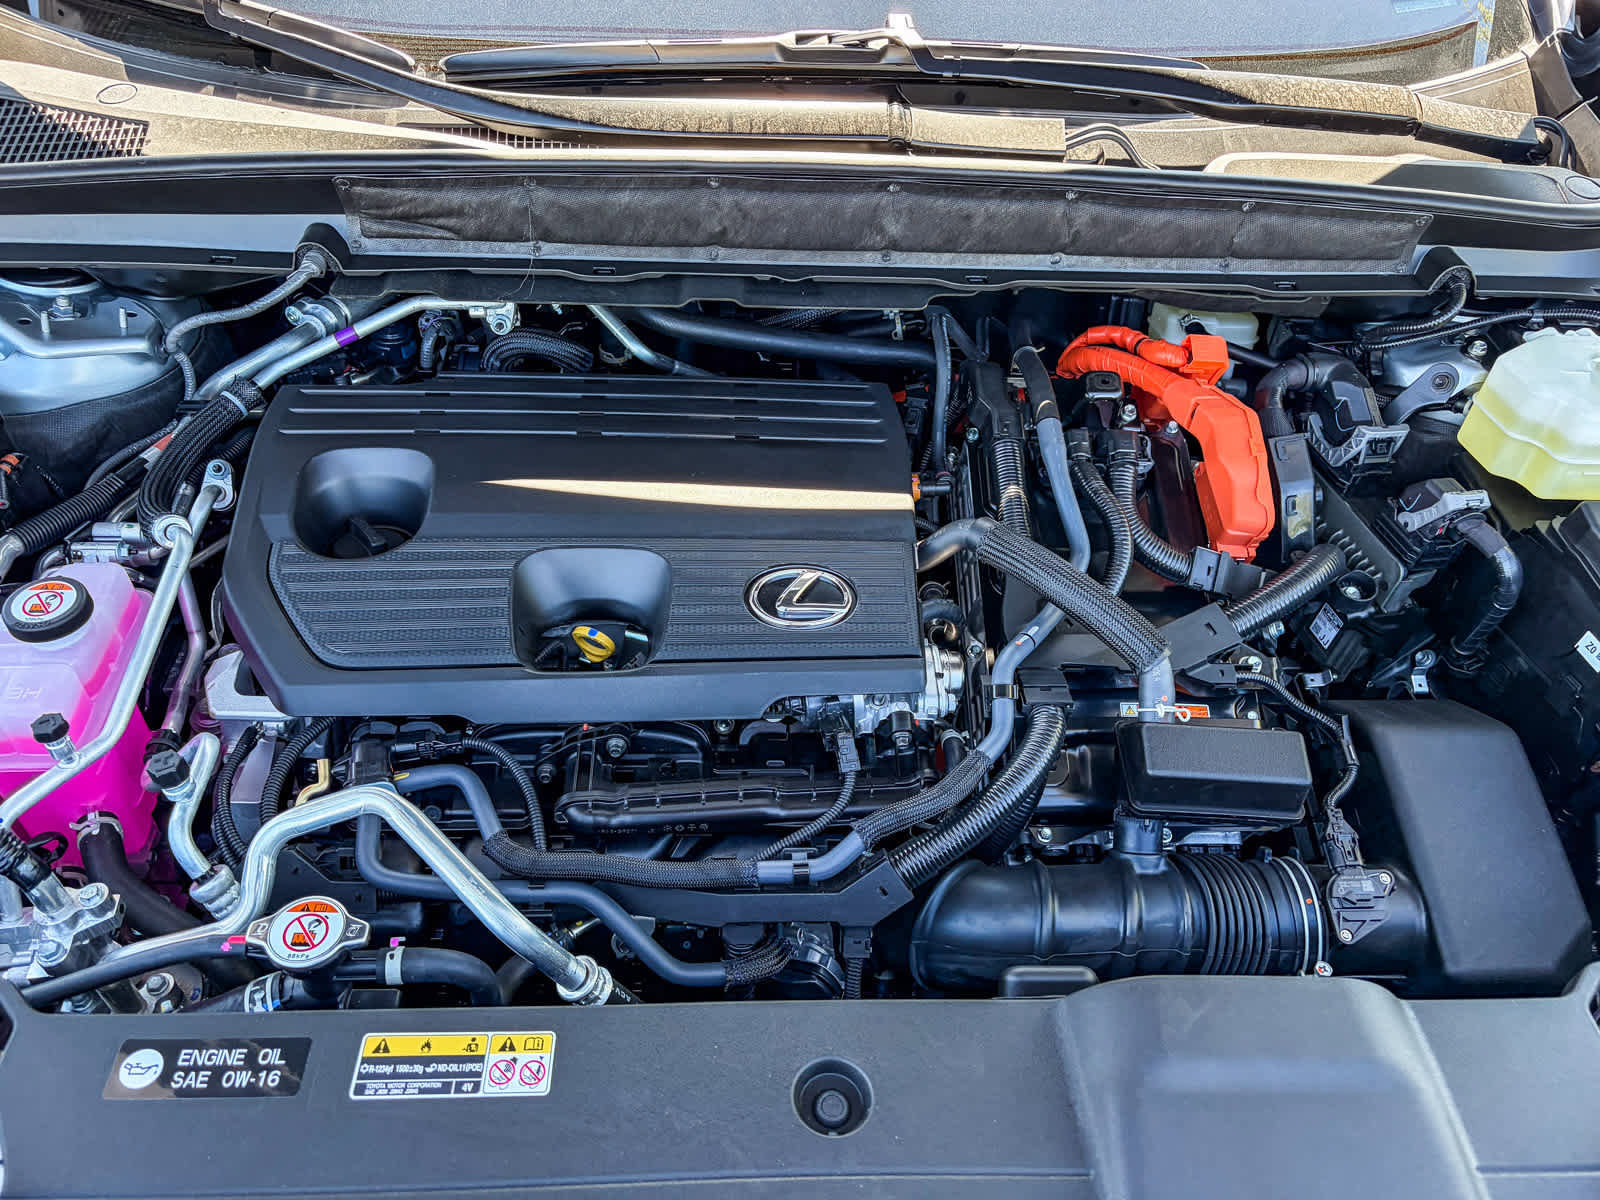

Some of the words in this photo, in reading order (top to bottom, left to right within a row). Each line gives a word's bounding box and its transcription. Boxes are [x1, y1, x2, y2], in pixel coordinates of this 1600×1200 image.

[177, 1048, 248, 1067] ENGINE
[257, 1047, 286, 1066] OIL
[170, 1071, 211, 1088] SAE
[461, 1082, 474, 1093] 4V
